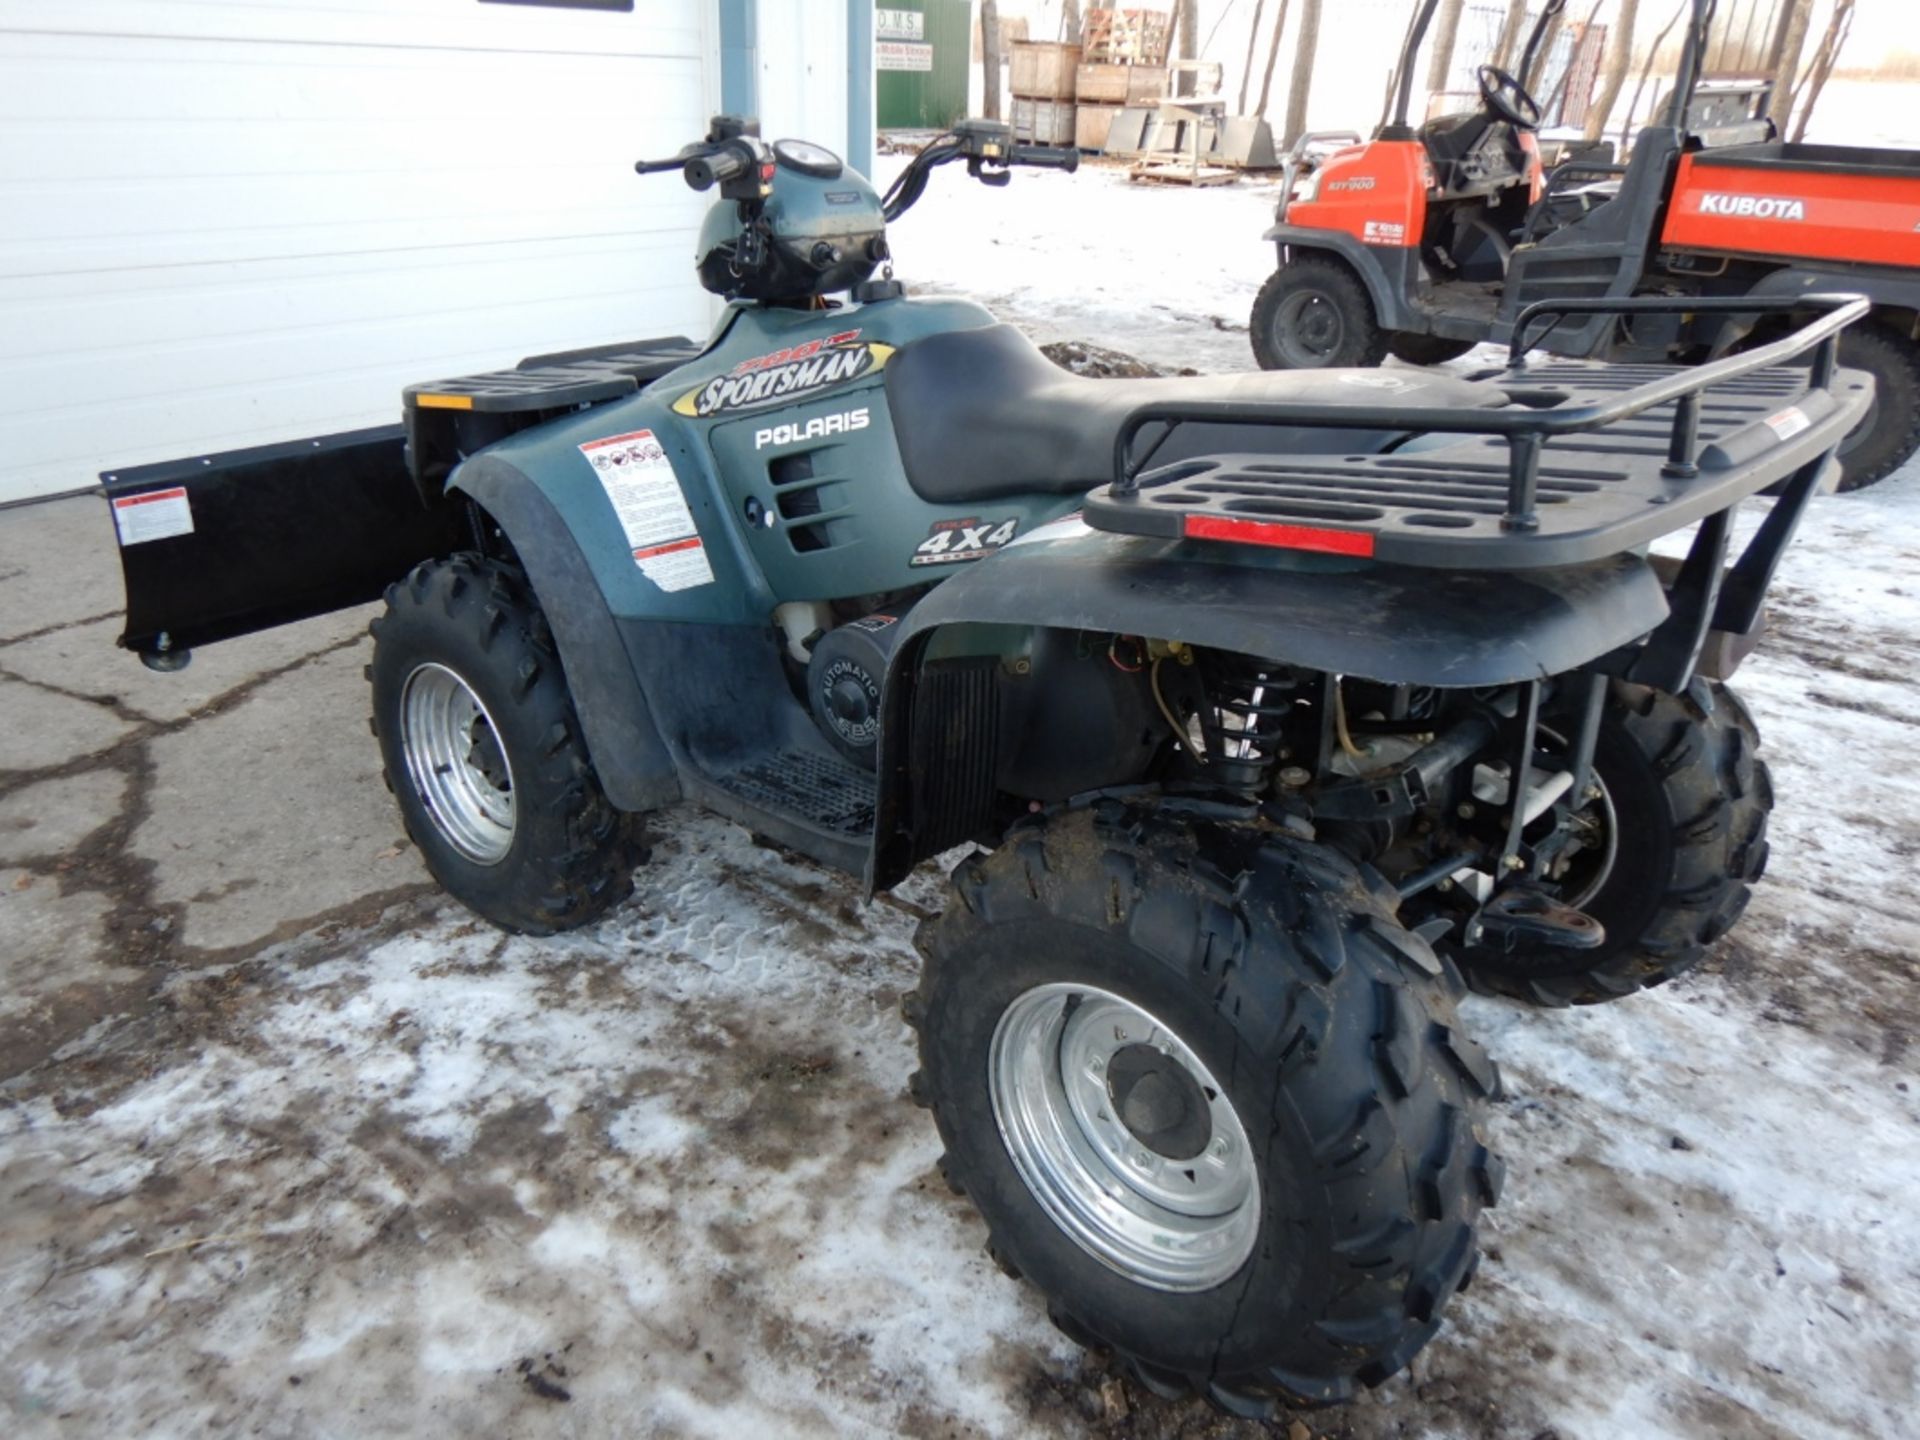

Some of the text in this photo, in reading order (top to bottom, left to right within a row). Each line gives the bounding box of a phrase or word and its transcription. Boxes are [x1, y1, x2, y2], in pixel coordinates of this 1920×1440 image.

[1699, 193, 1805, 220] KUBOTA
[698, 347, 868, 414] SPORTSMAN
[755, 408, 870, 450] POLARIS
[823, 661, 878, 698] AUTOMATIC
